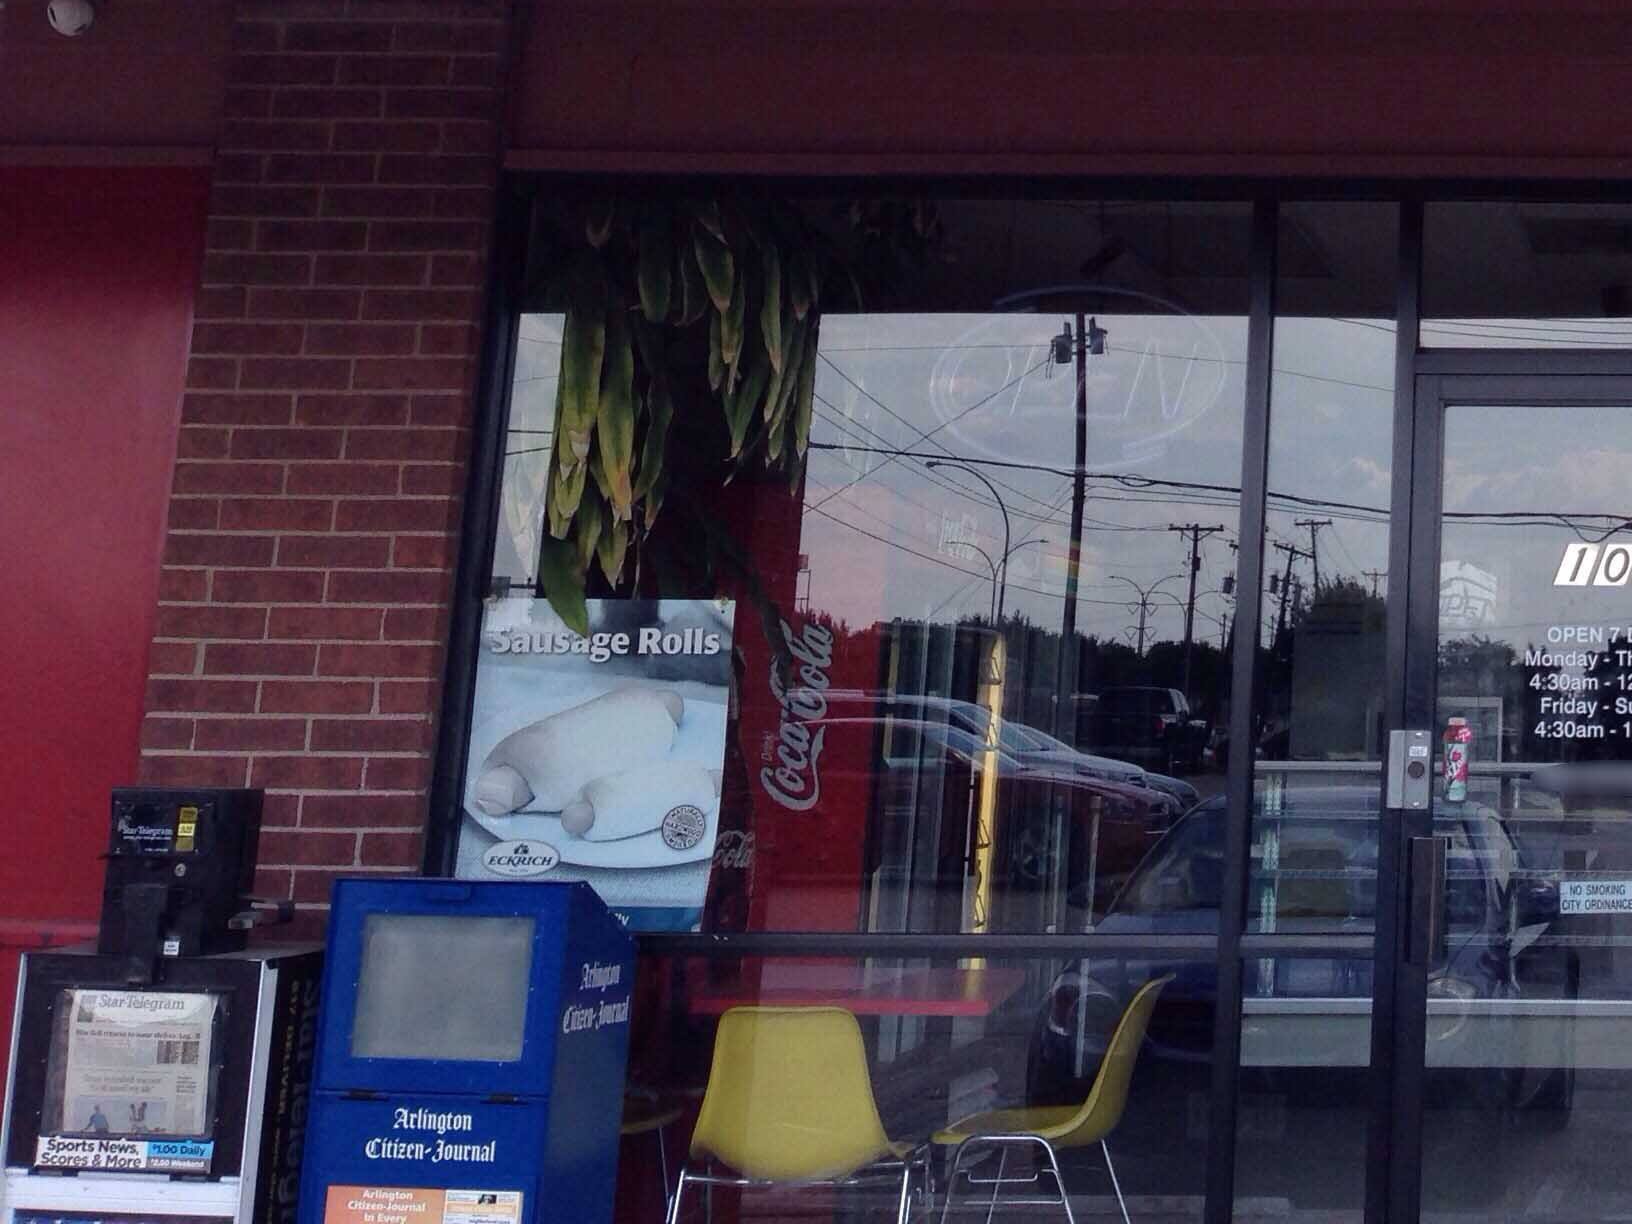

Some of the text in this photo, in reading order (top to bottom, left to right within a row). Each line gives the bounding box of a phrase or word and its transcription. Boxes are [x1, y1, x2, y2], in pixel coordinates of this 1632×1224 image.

[1547, 626, 1603, 643] OPEN
[1609, 627, 1621, 643] 7
[490, 627, 721, 663] Sausage Rolls
[1525, 650, 1599, 671] Monday
[1529, 673, 1599, 690] 4:30am
[1540, 697, 1598, 719] Friday
[1534, 721, 1604, 739] 4:30am
[488, 855, 553, 868] ECKRICH
[1569, 884, 1626, 896] NO SMOKING
[1562, 899, 1581, 911] CITY
[393, 1107, 473, 1135] Arlington
[47, 1139, 140, 1155] Sports News,
[180, 1145, 206, 1156] Daily
[364, 1137, 496, 1163] Citizen-Journal
[41, 1152, 142, 1169] Scores & More
[362, 1189, 413, 1201] Arlington
[347, 1200, 427, 1213] Citizen-Journal
[380, 1213, 408, 1224] Every
